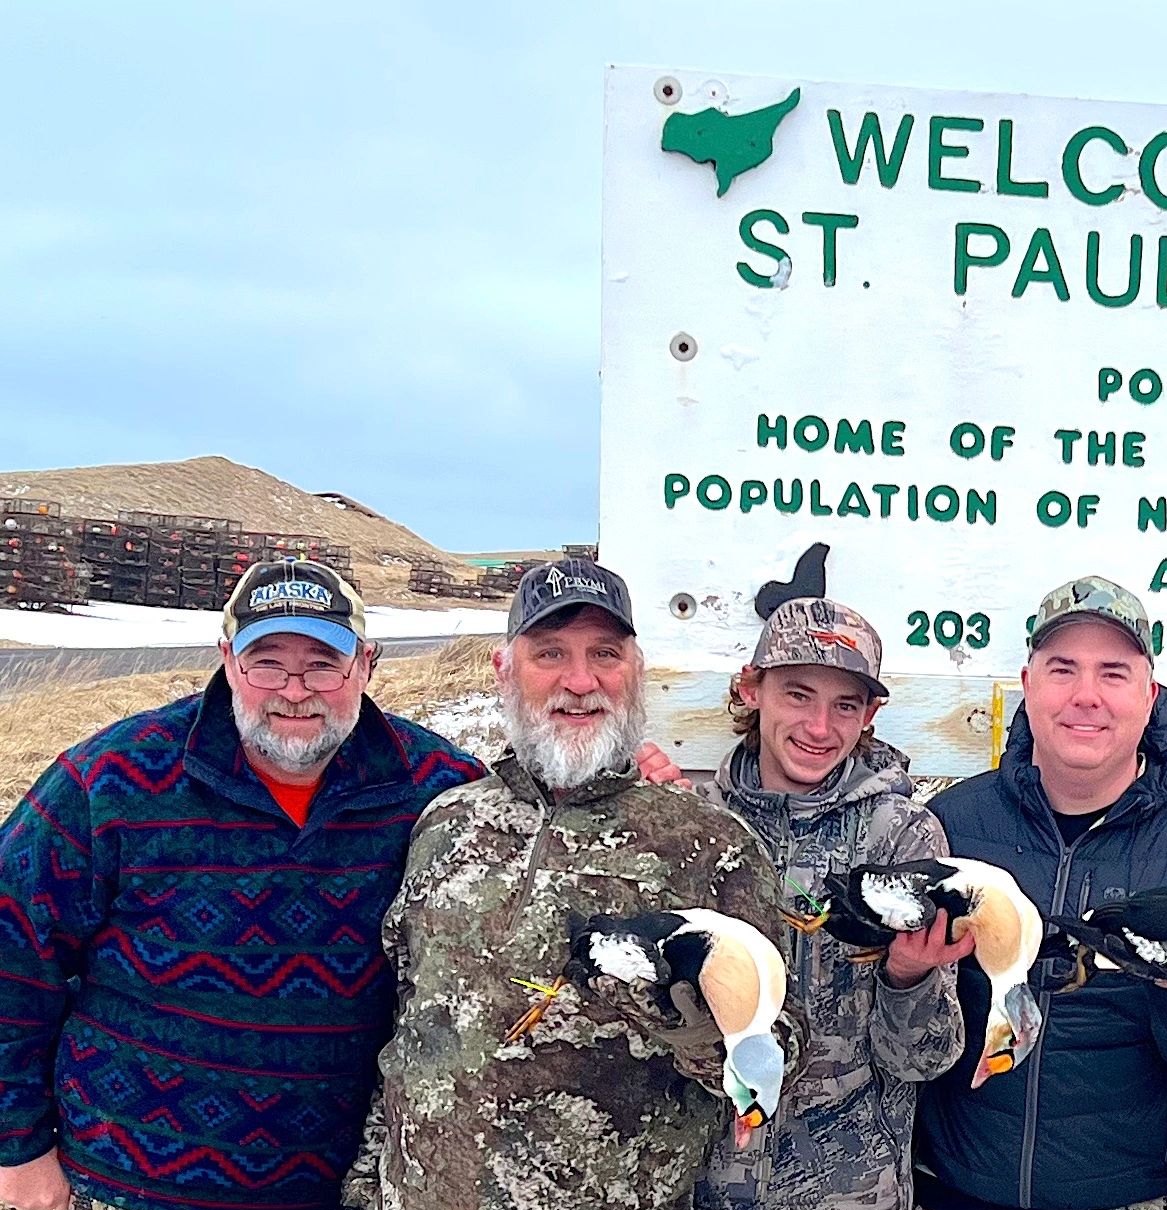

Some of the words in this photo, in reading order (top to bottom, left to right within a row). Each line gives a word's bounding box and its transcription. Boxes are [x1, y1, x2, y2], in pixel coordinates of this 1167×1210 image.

[736, 208, 871, 290] ST.
[756, 413, 906, 457] HOME
[949, 421, 1016, 461] OF
[1055, 429, 1147, 468] THE
[664, 473, 997, 526] POPULATION
[1036, 490, 1100, 529] OF
[249, 581, 333, 607] ALASKA
[907, 611, 991, 649] 203
